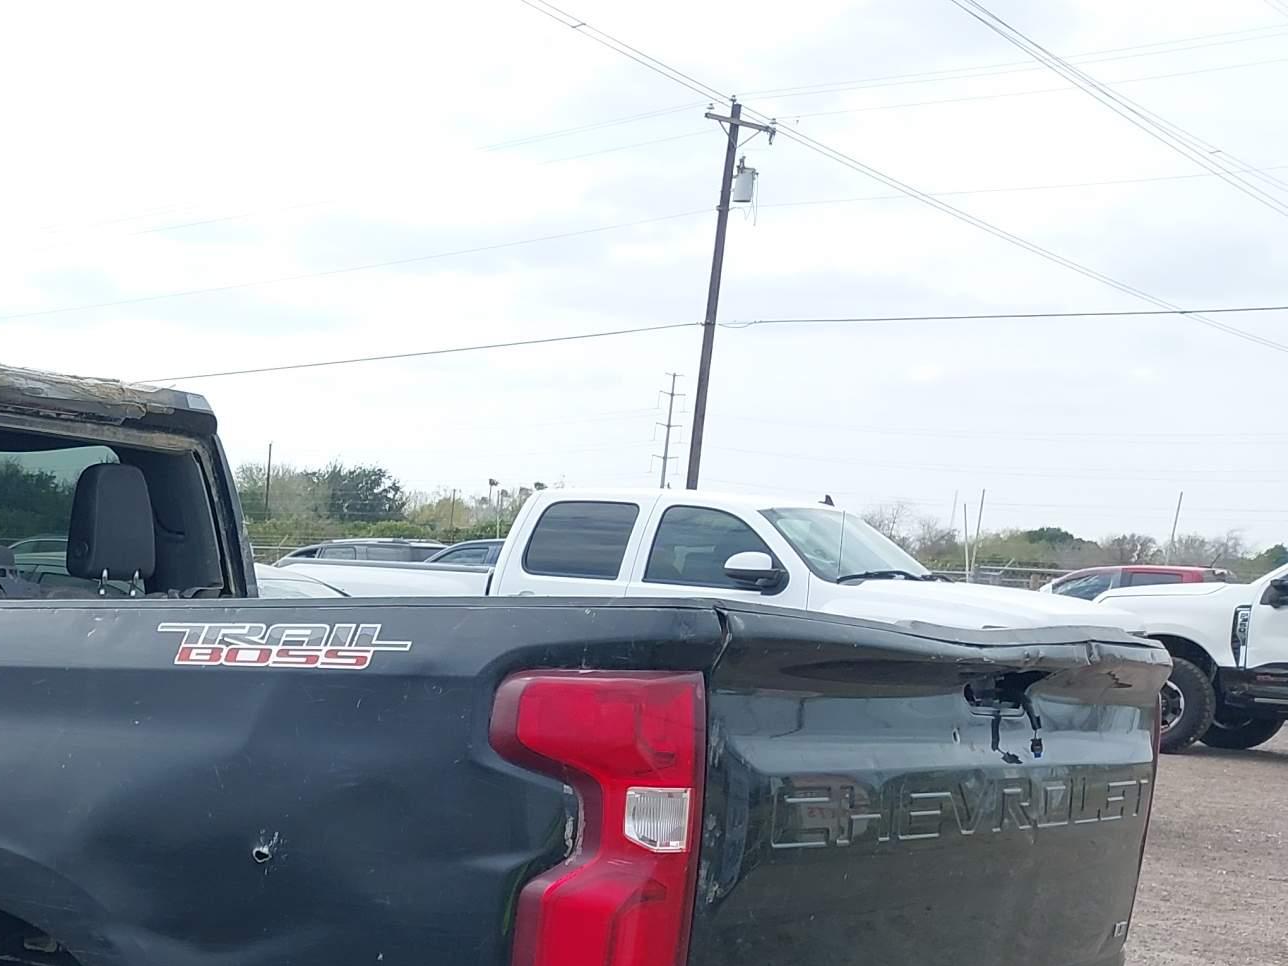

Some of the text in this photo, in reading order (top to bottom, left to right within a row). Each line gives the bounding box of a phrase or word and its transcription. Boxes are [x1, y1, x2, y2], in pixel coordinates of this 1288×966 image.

[157, 622, 412, 651] TRAIL
[174, 645, 374, 669] BOSS
[771, 776, 1150, 848] CHEVROLET
